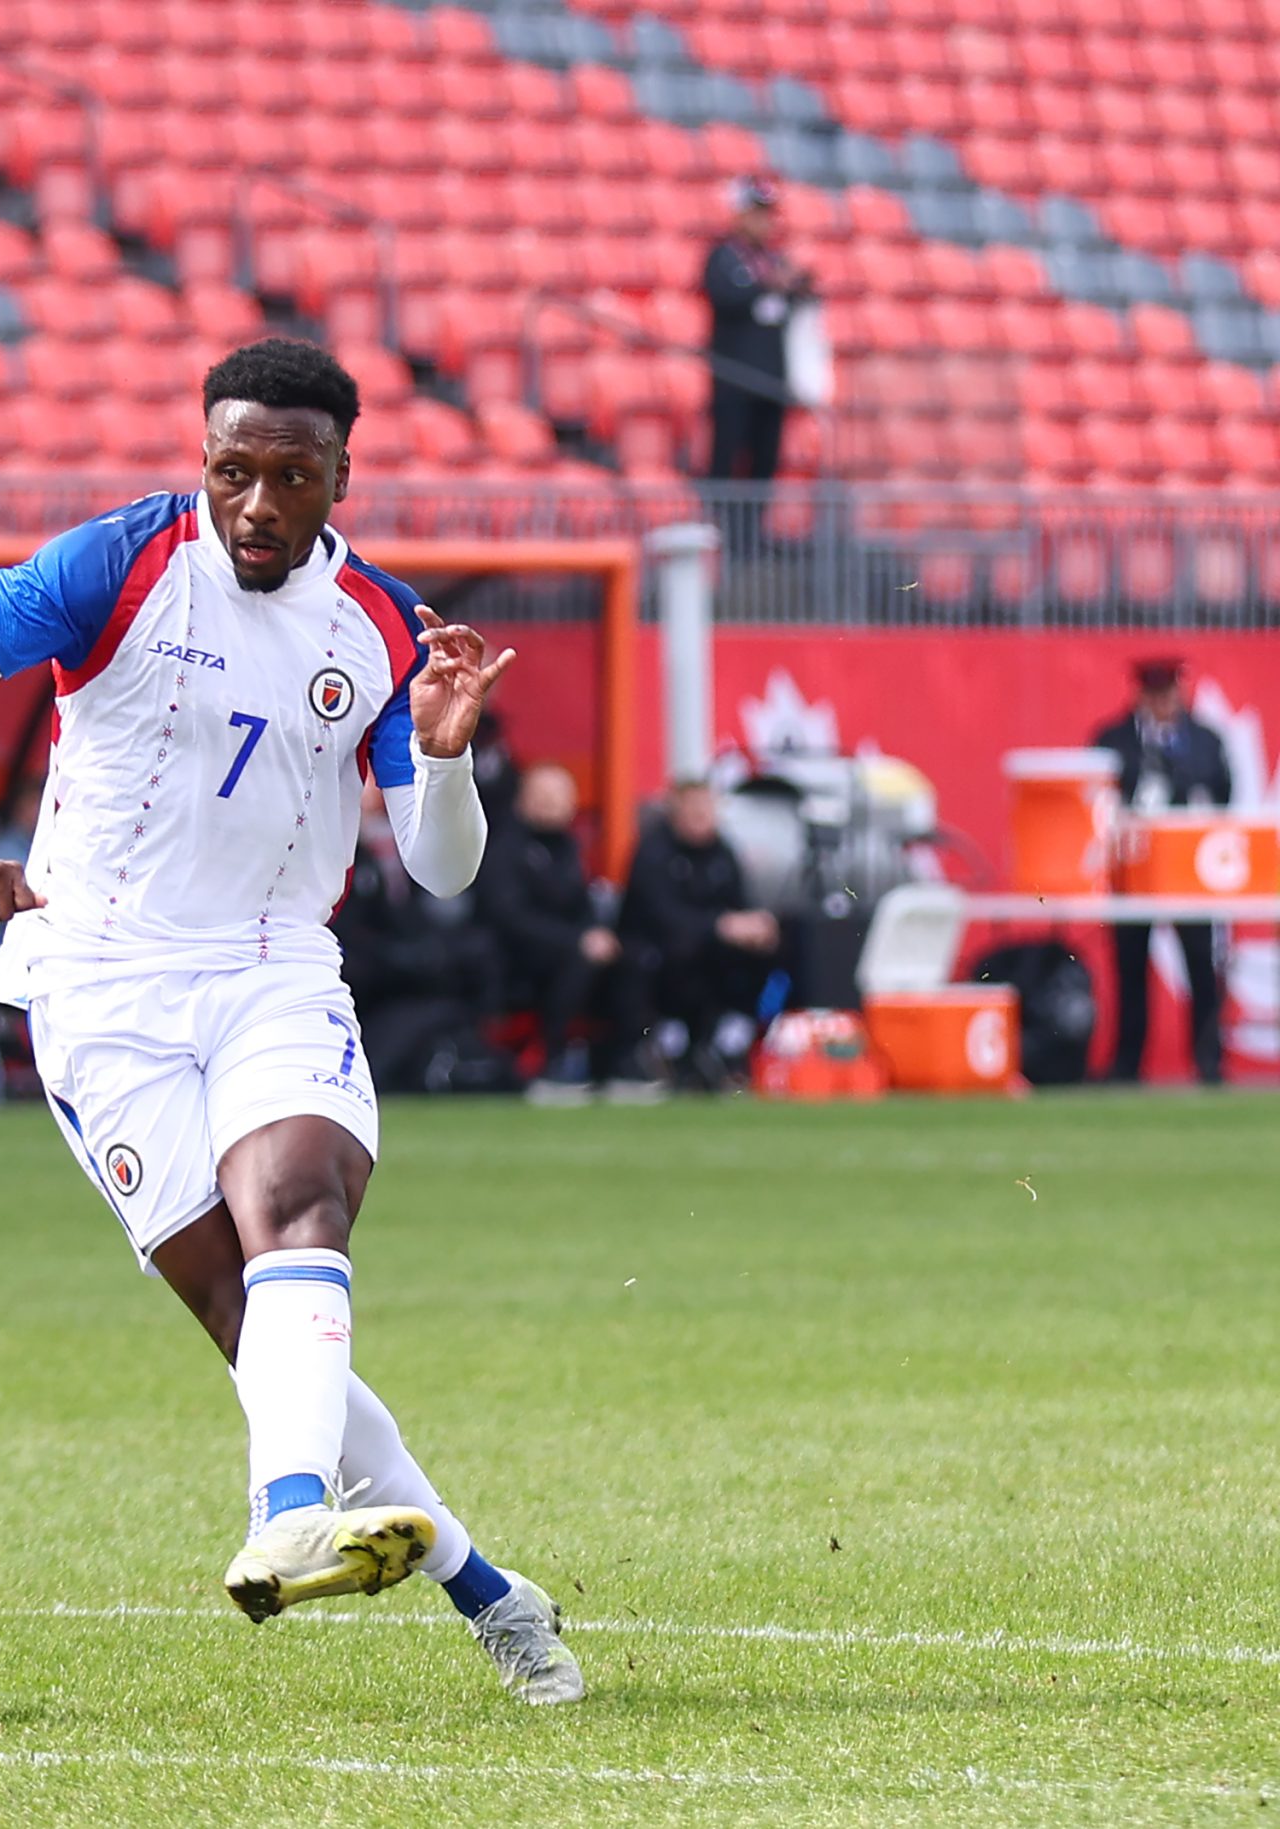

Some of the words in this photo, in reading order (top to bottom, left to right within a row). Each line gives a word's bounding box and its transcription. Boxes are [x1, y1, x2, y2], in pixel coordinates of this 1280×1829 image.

[146, 640, 226, 672] SAETA
[216, 710, 269, 799] 7
[326, 1009, 356, 1077] 7
